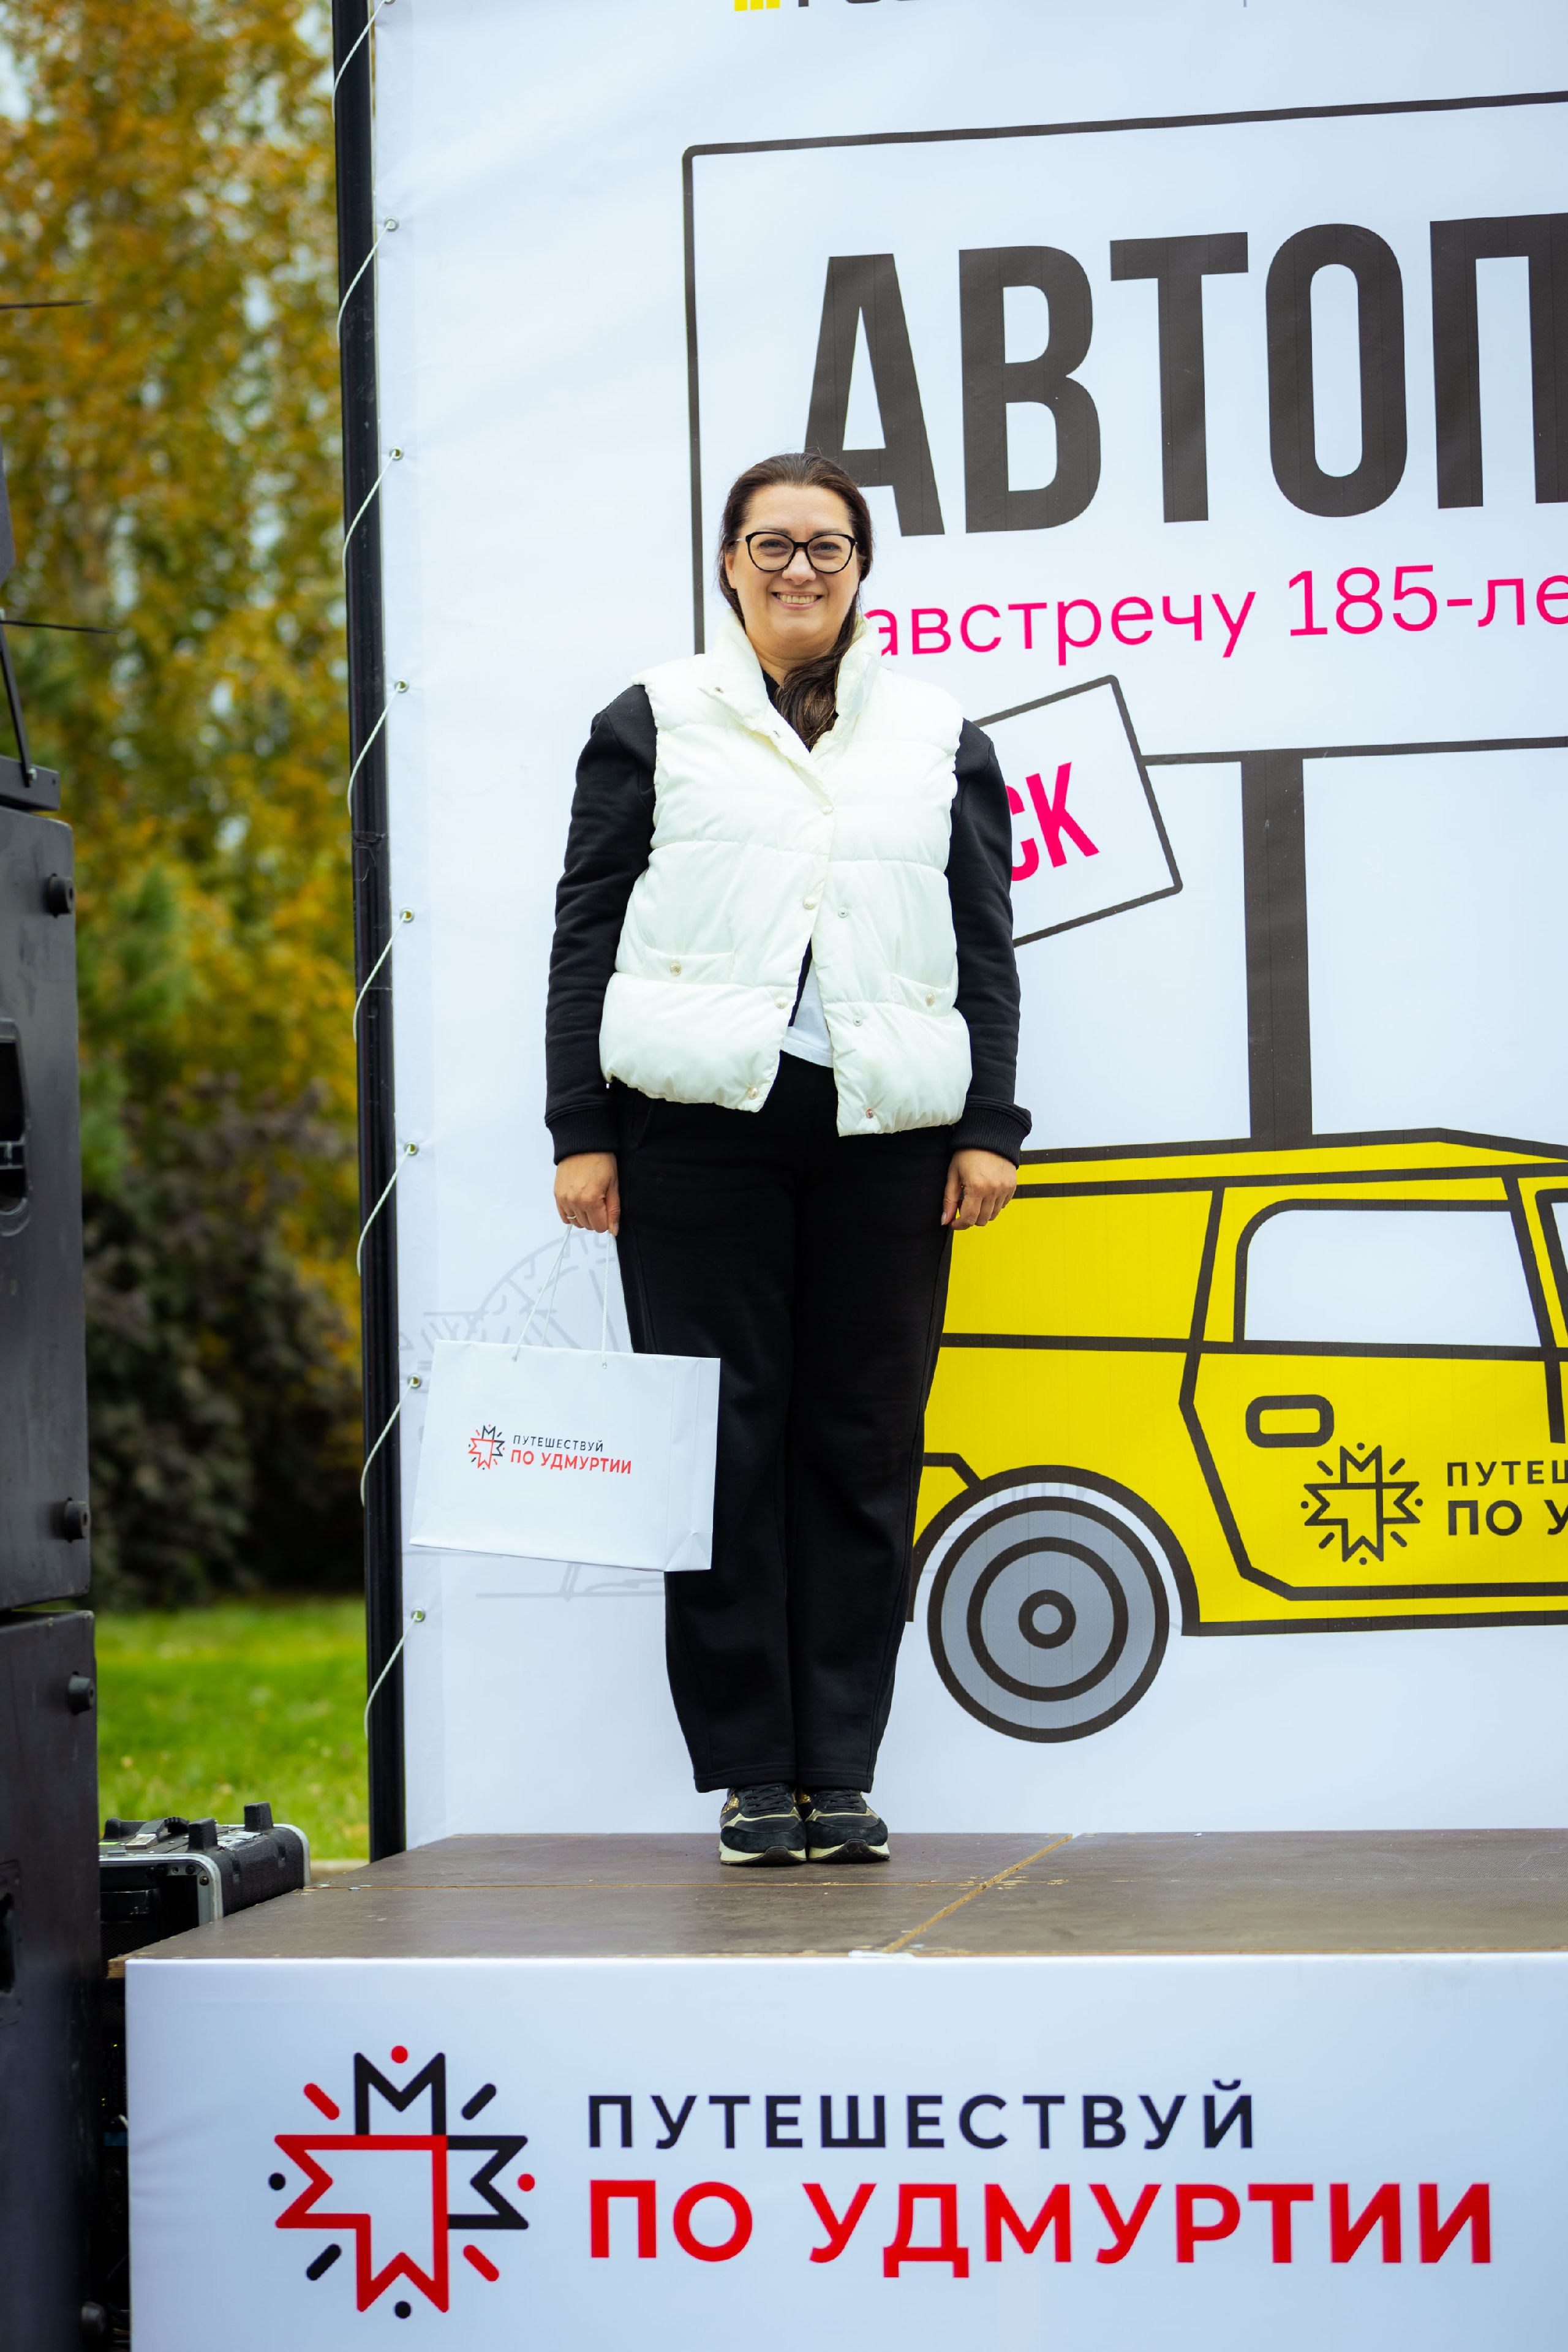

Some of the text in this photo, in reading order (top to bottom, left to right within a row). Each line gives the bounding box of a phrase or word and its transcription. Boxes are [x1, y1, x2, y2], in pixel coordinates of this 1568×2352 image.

[804, 213, 1568, 537] АВТОП
[1289, 564, 1568, 636] 185-ле
[510, 1449, 631, 1474] ПО УДМУРТИИ
[513, 1434, 604, 1452] ПУТЕШЕСТВУЙ
[1448, 1499, 1568, 1536] ПО У
[589, 2080, 1253, 2150] ПУТЕШЕСТВУЙ
[589, 2179, 1491, 2278] ПО УДМУРТИИ
